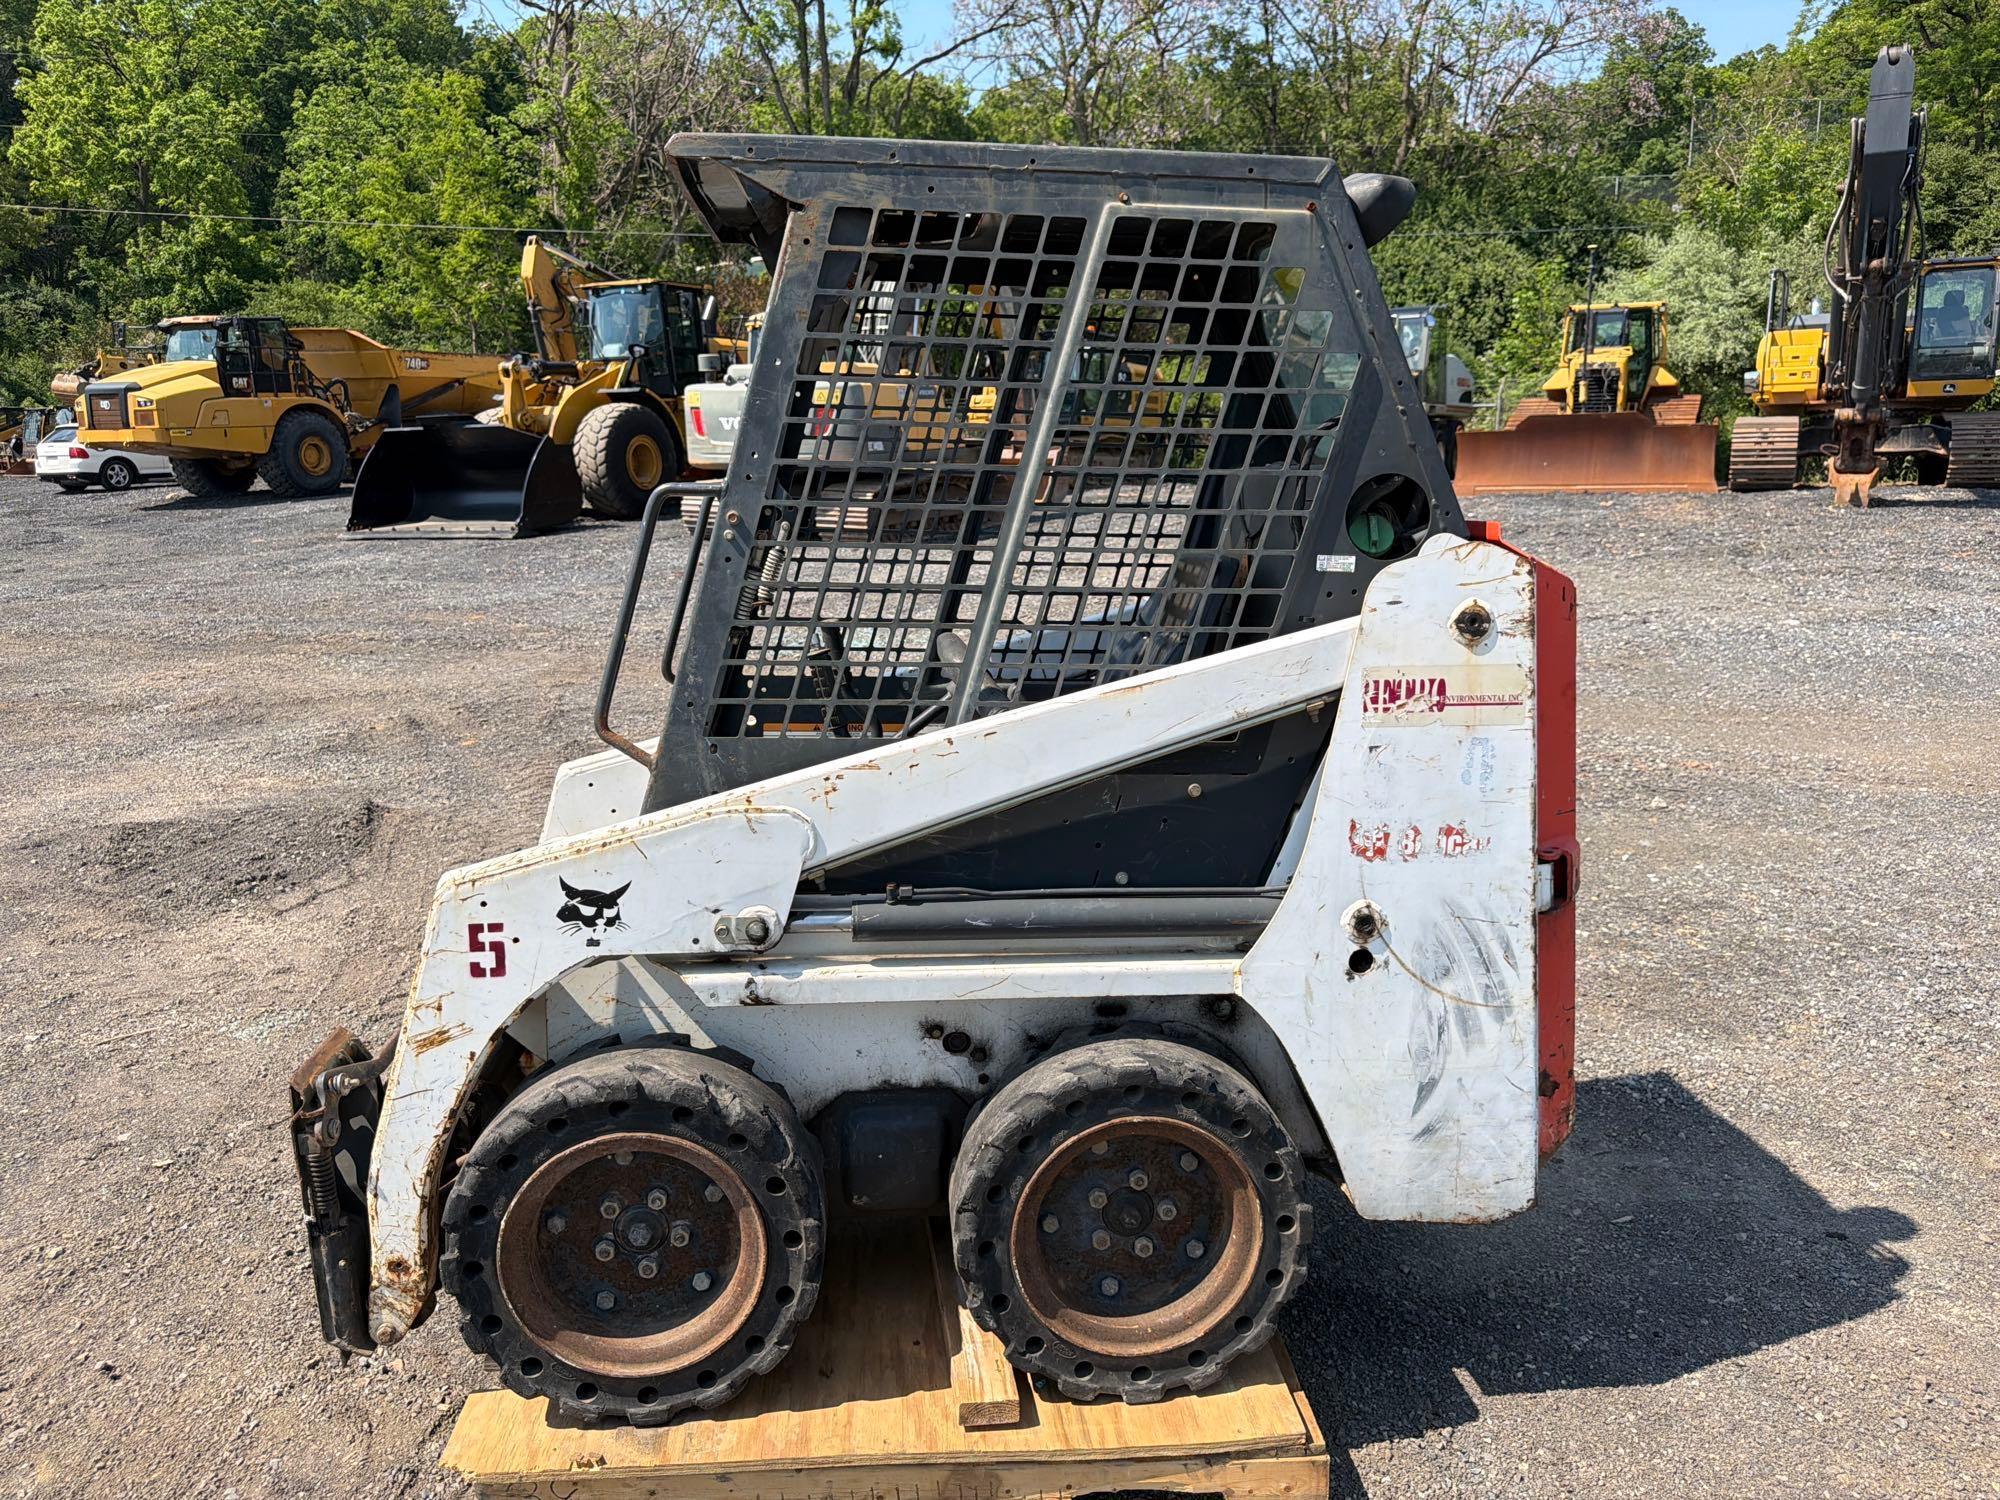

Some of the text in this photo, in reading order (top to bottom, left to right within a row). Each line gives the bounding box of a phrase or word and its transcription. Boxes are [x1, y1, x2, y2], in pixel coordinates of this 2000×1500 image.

[405, 357, 421, 369] 740
[232, 376, 248, 389] CAT
[1440, 694, 1507, 703] ENVIRONMENTAL
[468, 922, 507, 978] 5
